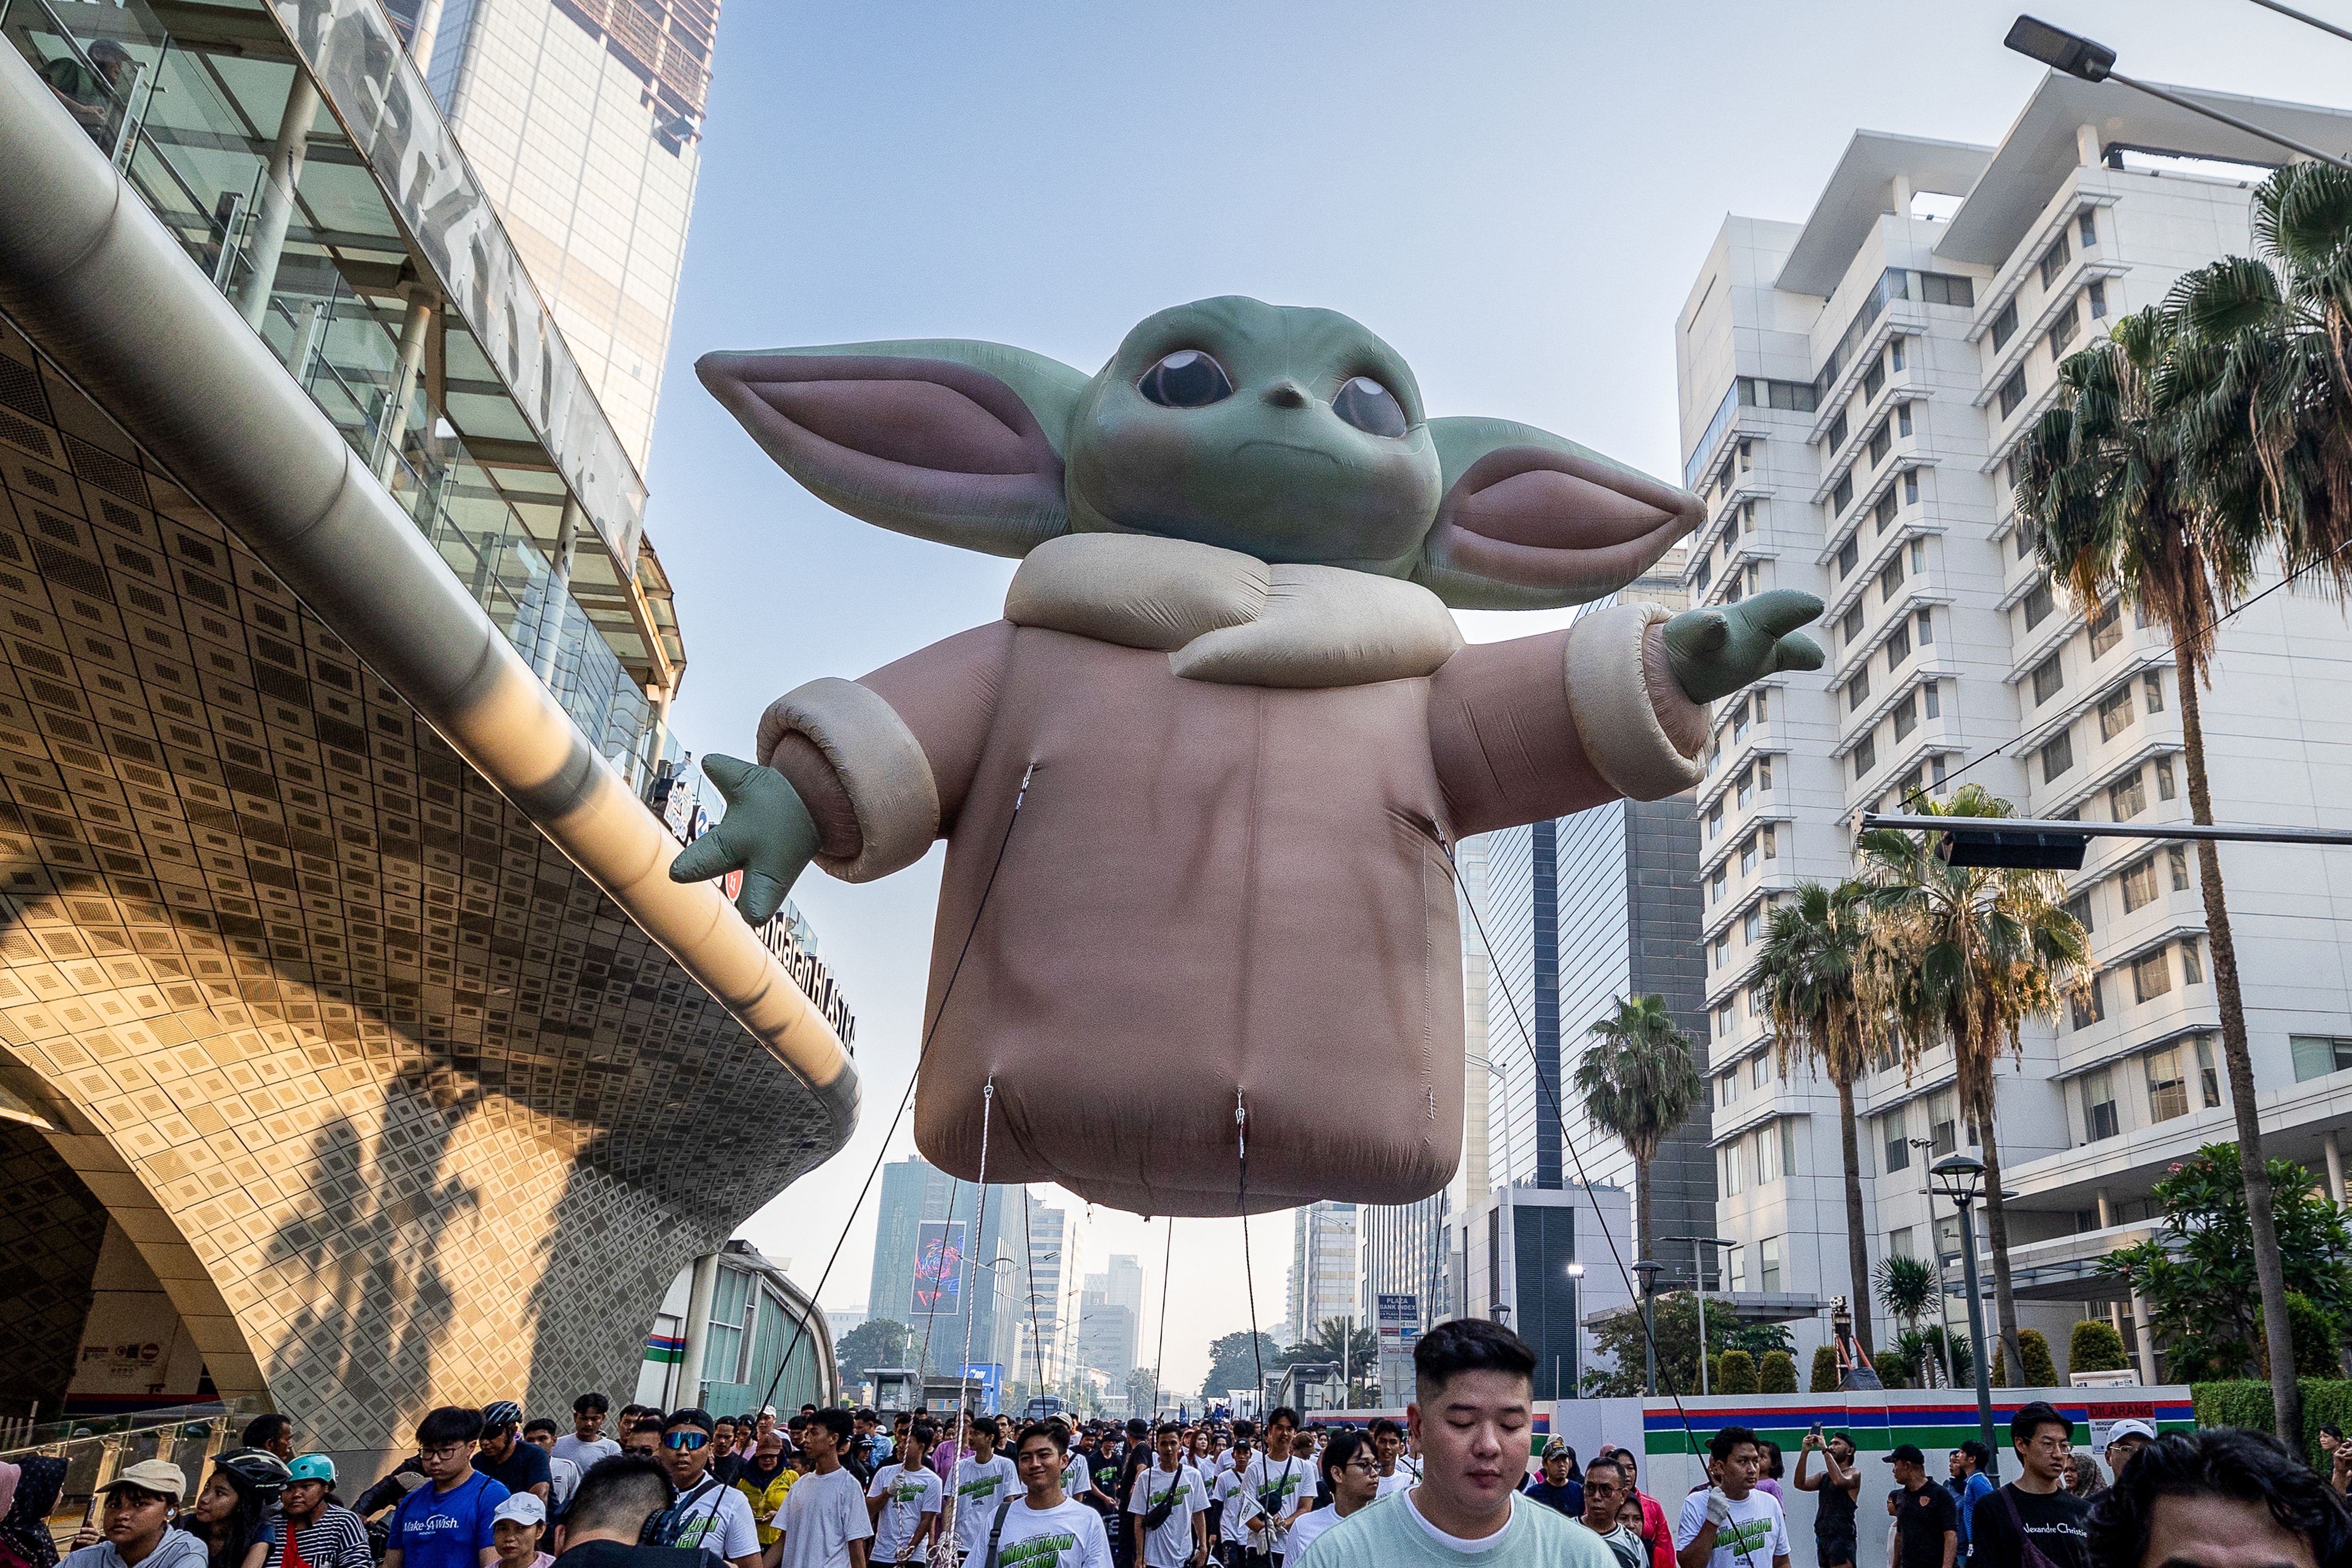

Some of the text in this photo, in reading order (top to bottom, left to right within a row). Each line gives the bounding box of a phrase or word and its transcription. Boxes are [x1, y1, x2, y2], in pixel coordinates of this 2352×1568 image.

[811, 958, 827, 1011] HI
[825, 978, 857, 1059] ASTRA
[2090, 1405, 2153, 1417] DILARANG
[2057, 1523, 2087, 1537] Christie
